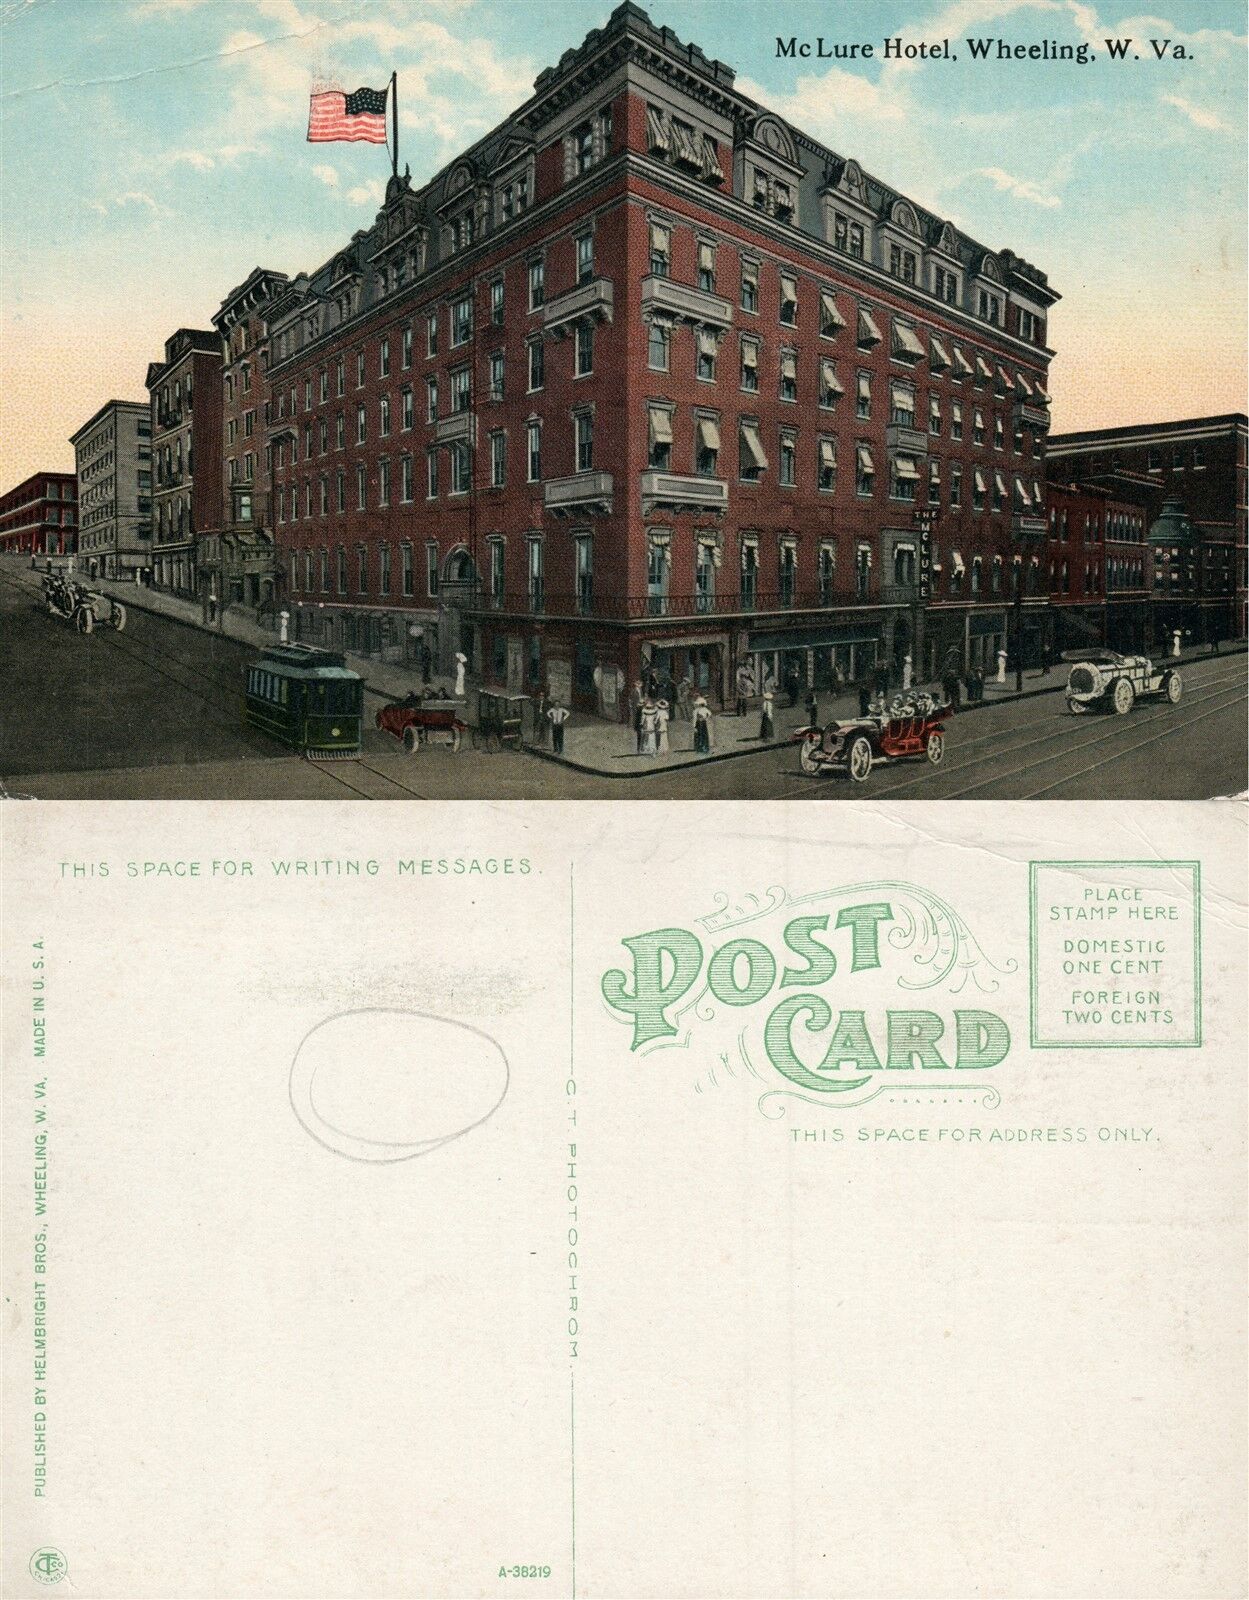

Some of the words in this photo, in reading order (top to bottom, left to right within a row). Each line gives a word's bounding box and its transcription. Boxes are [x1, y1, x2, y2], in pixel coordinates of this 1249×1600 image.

[921, 523, 930, 597] MCLURE
[59, 861, 110, 878] THIS
[127, 861, 201, 877] SPACE
[212, 860, 254, 876] FOR
[272, 859, 380, 876] WRITING
[398, 858, 543, 876] MESSAGES.
[1083, 887, 1142, 901] PLACE
[1049, 905, 1118, 921] STAMP
[1128, 905, 1179, 921] HERE
[1063, 939, 1166, 954] DOMESTIC
[1062, 960, 1102, 975] ONE
[1110, 959, 1163, 975] CENT
[601, 902, 894, 1052] POST
[33, 997, 45, 1012] IN
[1071, 990, 1160, 1005] FOREIGN
[1061, 1010, 1103, 1024] TWO
[1111, 1009, 1174, 1025] CENTS
[33, 1017, 46, 1057] MADE
[764, 993, 1011, 1092] CARD
[34, 1104, 47, 1124] W.
[790, 1128, 844, 1142] THIS
[857, 1128, 929, 1142] SPACE
[937, 1128, 982, 1142] FOR
[988, 1128, 1087, 1142] ADDRESS
[1097, 1127, 1161, 1143] ONLY.
[34, 1130, 49, 1217] WHEELING,
[34, 1281, 47, 1381] HELMBRIGHT
[34, 1387, 47, 1406] BY
[34, 1411, 47, 1497] PUBLISHED
[498, 1565, 552, 1579] A-38219
